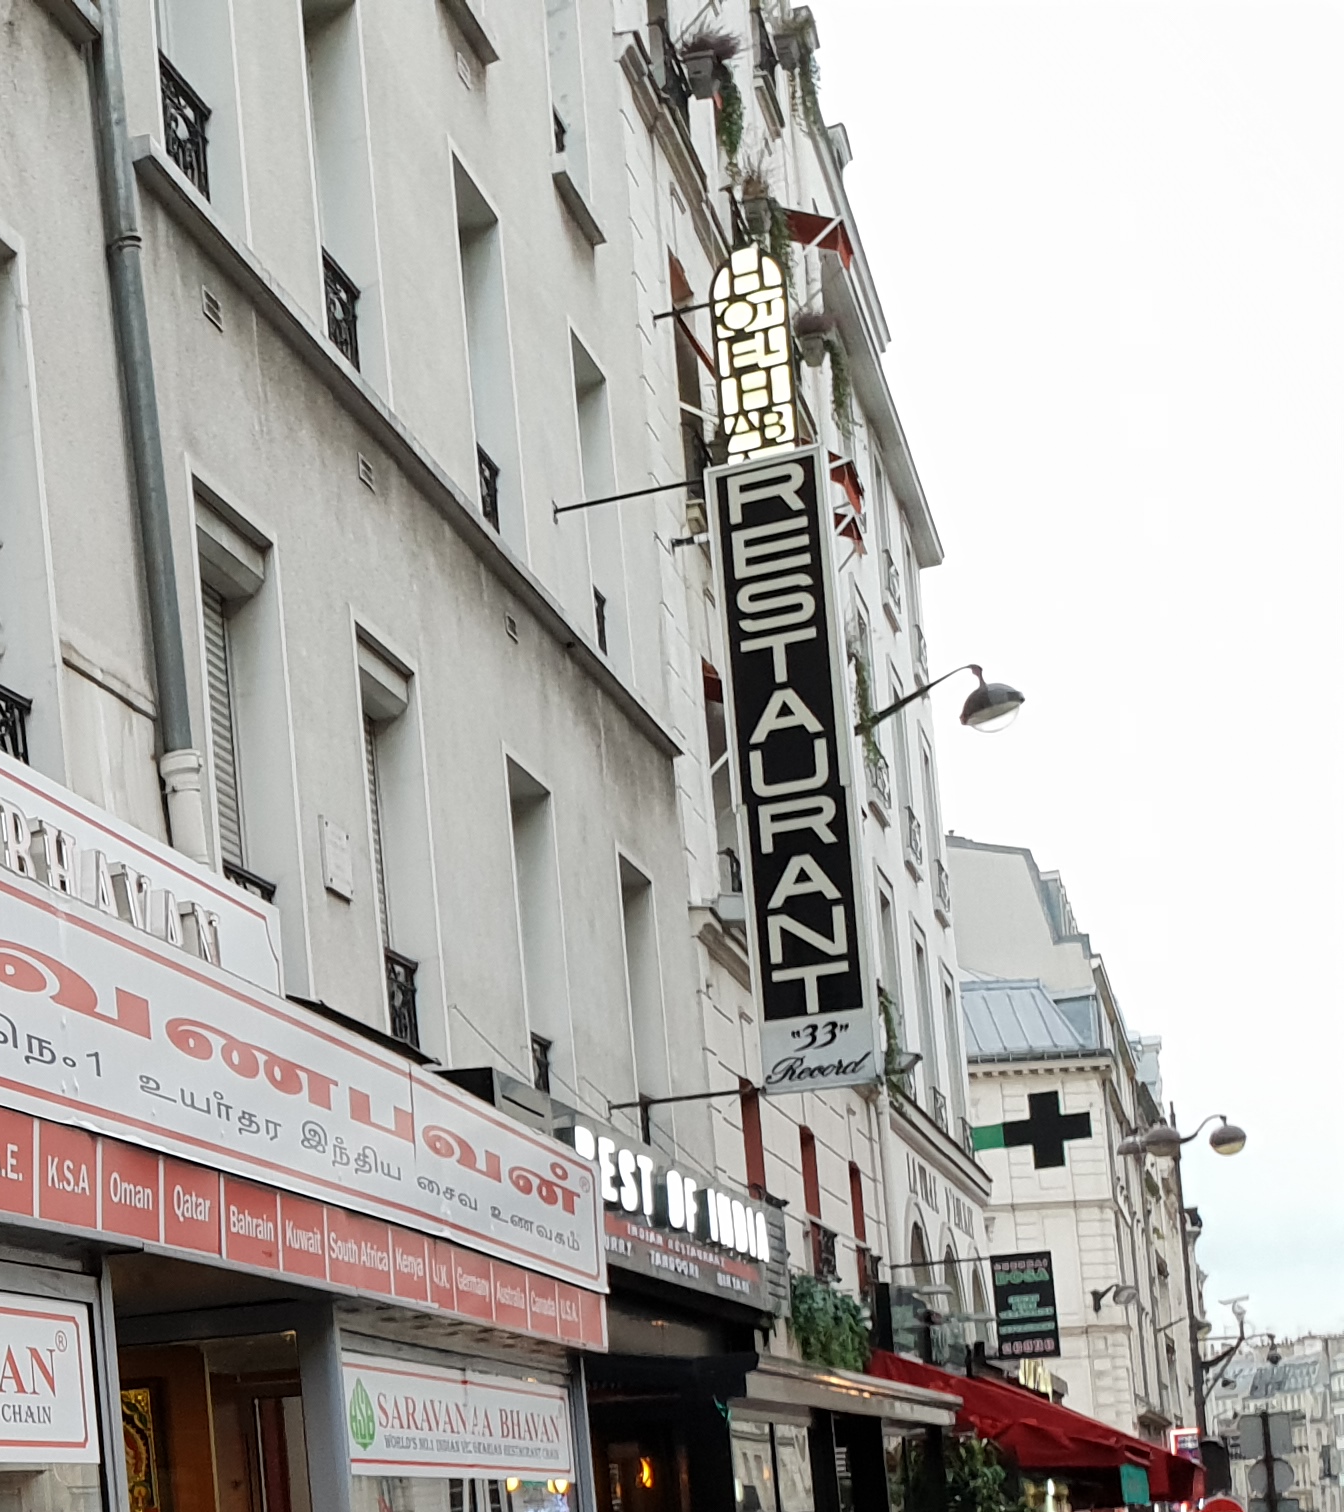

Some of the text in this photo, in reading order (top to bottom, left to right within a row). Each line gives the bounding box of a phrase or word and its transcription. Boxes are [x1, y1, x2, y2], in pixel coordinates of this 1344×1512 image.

[727, 461, 856, 1014] RESTAURANT
[766, 1051, 871, 1084] Record
[140, 1074, 282, 1142] உயர்தர
[300, 1120, 402, 1182] இந்திய
[47, 1155, 90, 1196] K.S.A
[110, 1172, 153, 1211] Oman
[173, 1185, 211, 1222] Qatar
[666, 1170, 698, 1233] OF
[706, 1188, 770, 1262] INDIA
[229, 1204, 275, 1242] Bahrain
[285, 1219, 323, 1255] Kuwait
[329, 1233, 389, 1272] South Africa
[395, 1248, 424, 1277] Kenya
[604, 1235, 632, 1257] URRY
[627, 1222, 725, 1268] INDIAN RESTAURANT
[650, 1251, 700, 1279] TANDOORI
[716, 1271, 751, 1295] BIRYANI
[457, 1266, 490, 1302] Germany
[496, 1279, 526, 1310] Australia
[530, 1290, 556, 1316] Canada
[1, 1404, 53, 1425] CHAIN
[377, 1393, 560, 1443] SARAVANAA BHAVAN
[384, 1434, 417, 1450] WORLD'S
